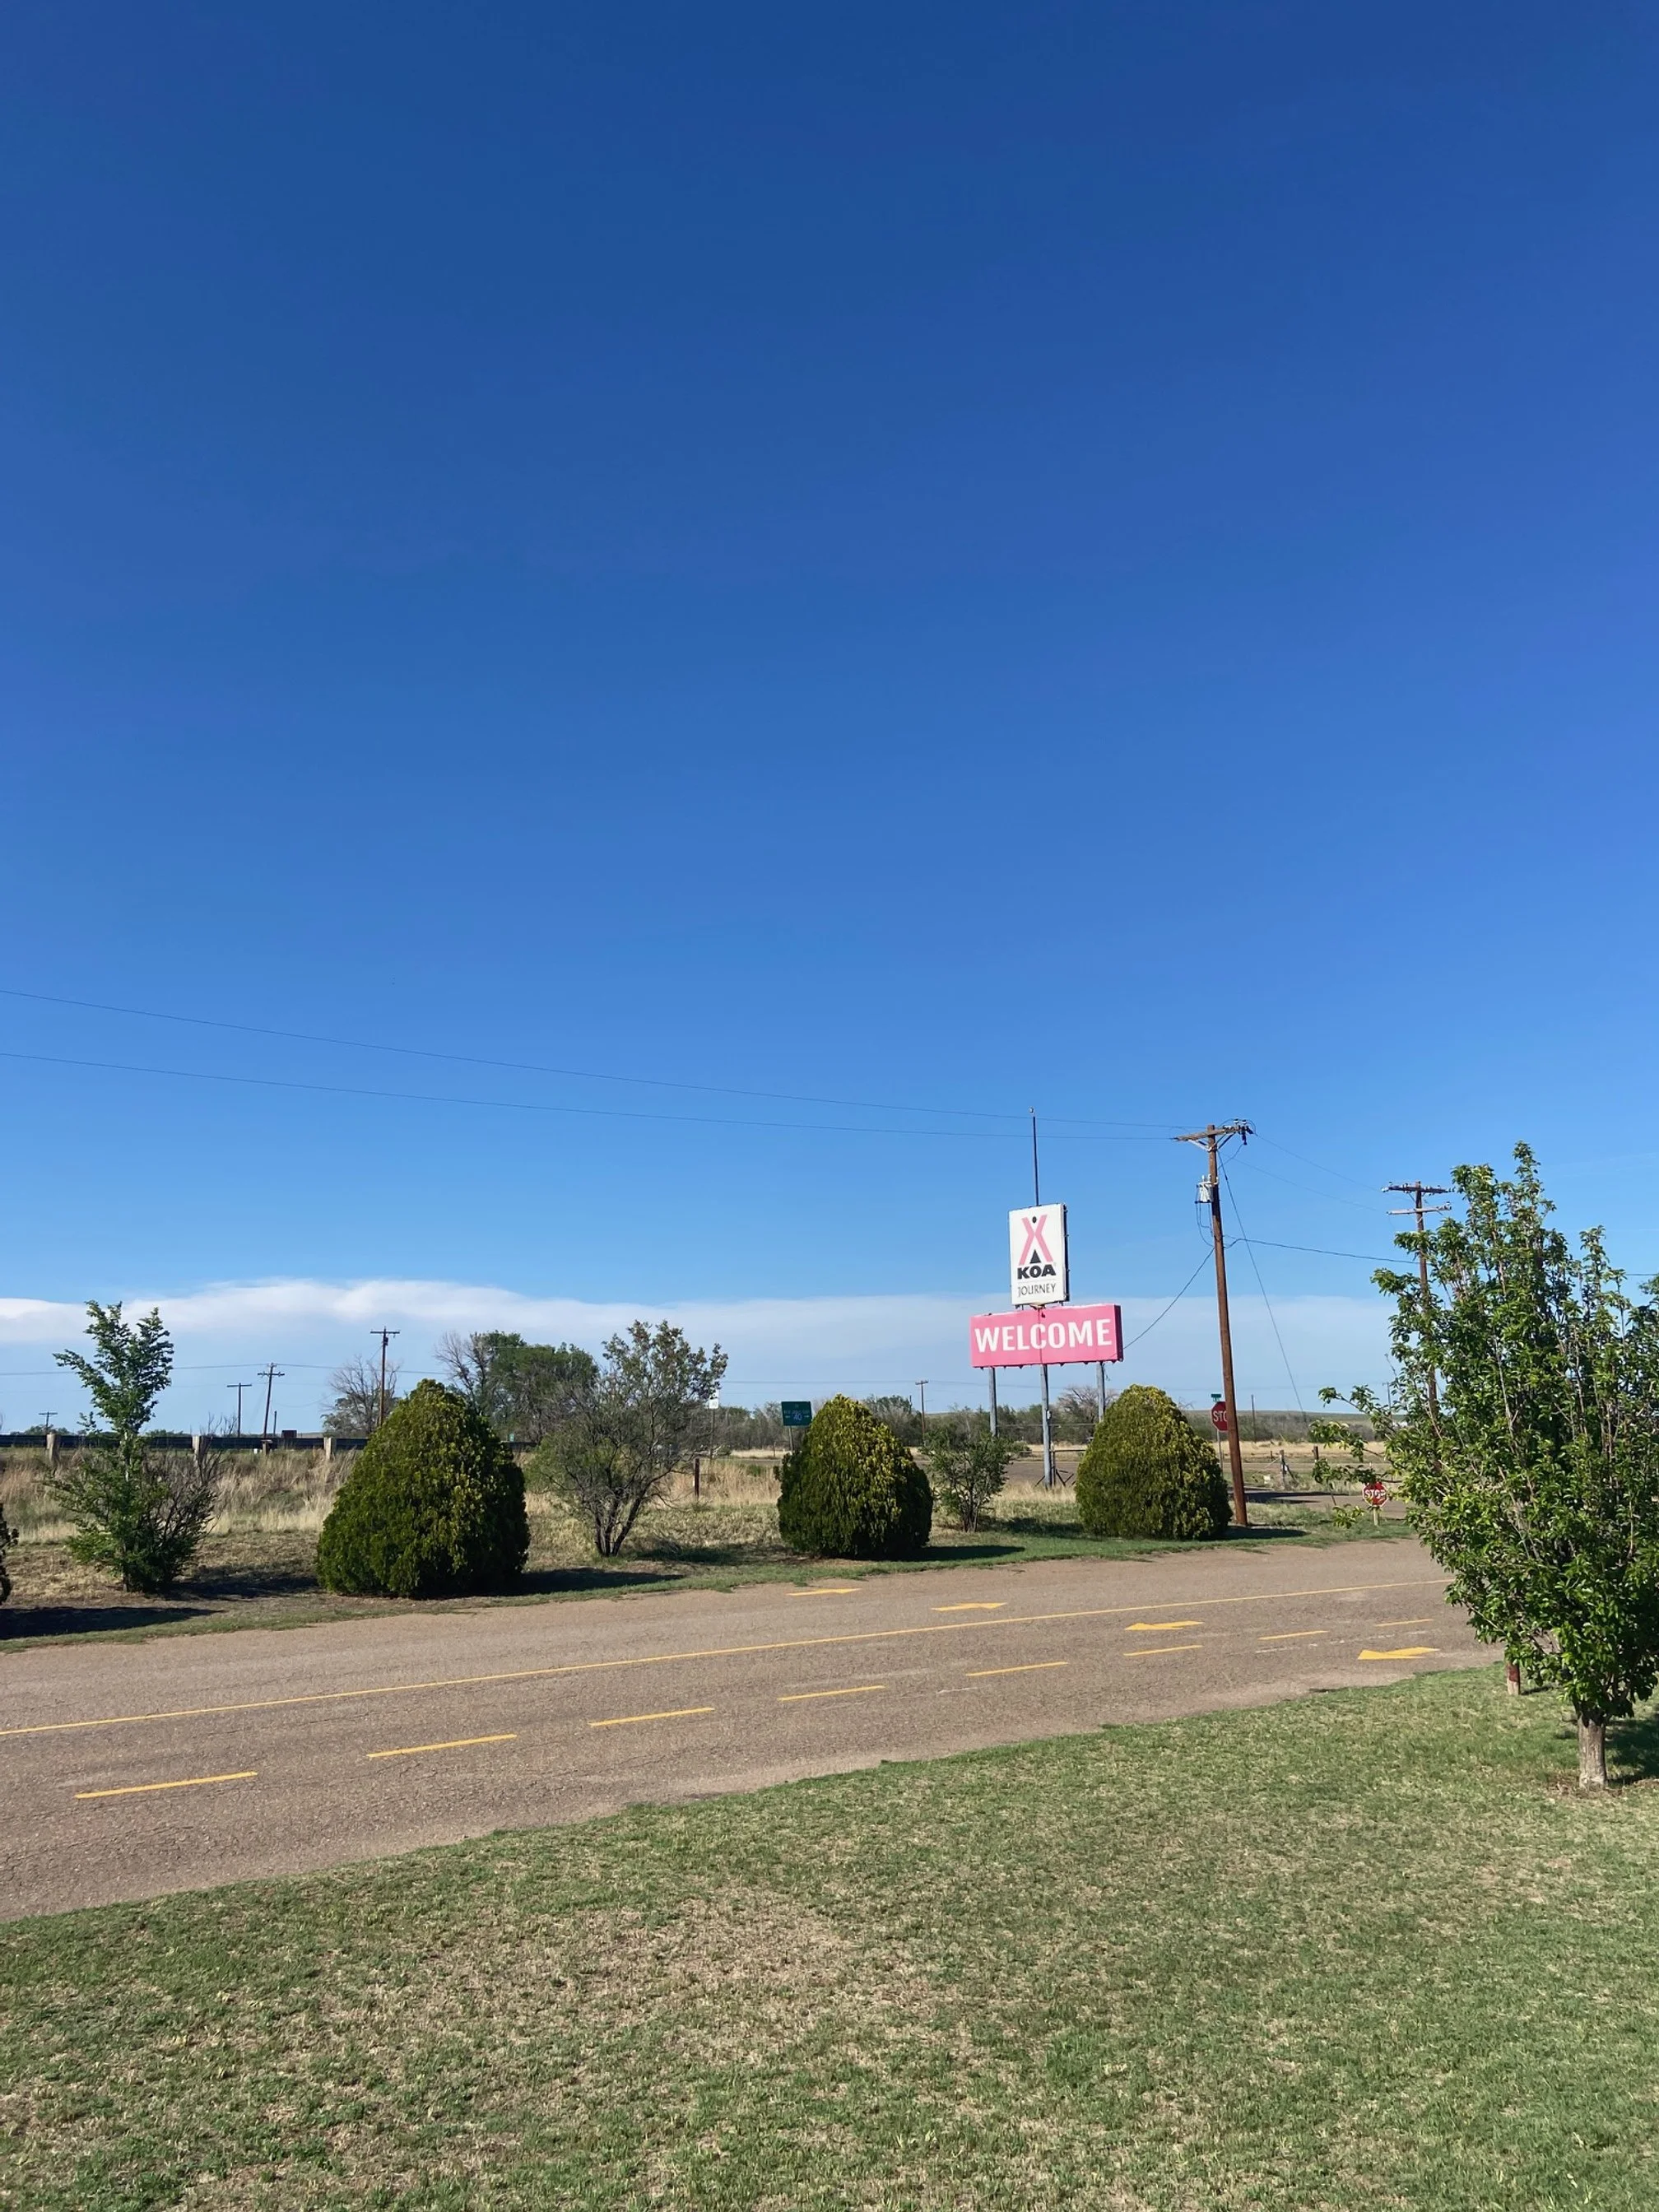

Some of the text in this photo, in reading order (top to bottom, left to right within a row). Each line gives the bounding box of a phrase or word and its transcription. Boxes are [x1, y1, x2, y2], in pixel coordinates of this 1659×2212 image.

[1017, 1264, 1057, 1280] KOA
[1017, 1283, 1057, 1298] JOURNEY
[974, 1318, 1113, 1353] WELCOME
[1213, 1410, 1227, 1422] STO
